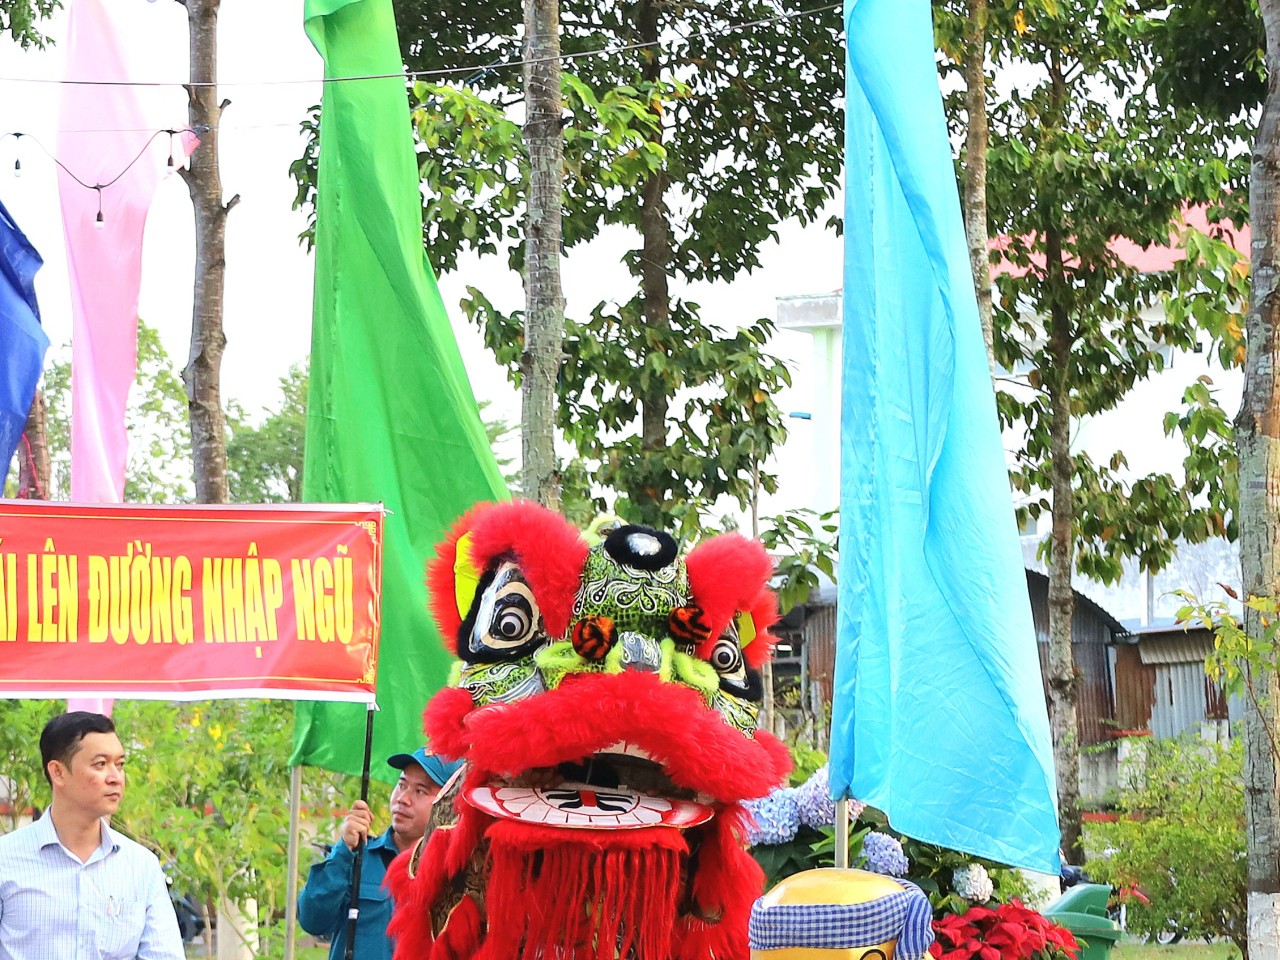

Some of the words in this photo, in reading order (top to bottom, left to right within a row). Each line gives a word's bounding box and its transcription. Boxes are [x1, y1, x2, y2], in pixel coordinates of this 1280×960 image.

[27, 538, 78, 643] LÊN
[88, 540, 194, 645] ĐƯỜNG
[202, 541, 284, 659] NHẬP
[291, 544, 354, 645] NGŨ
